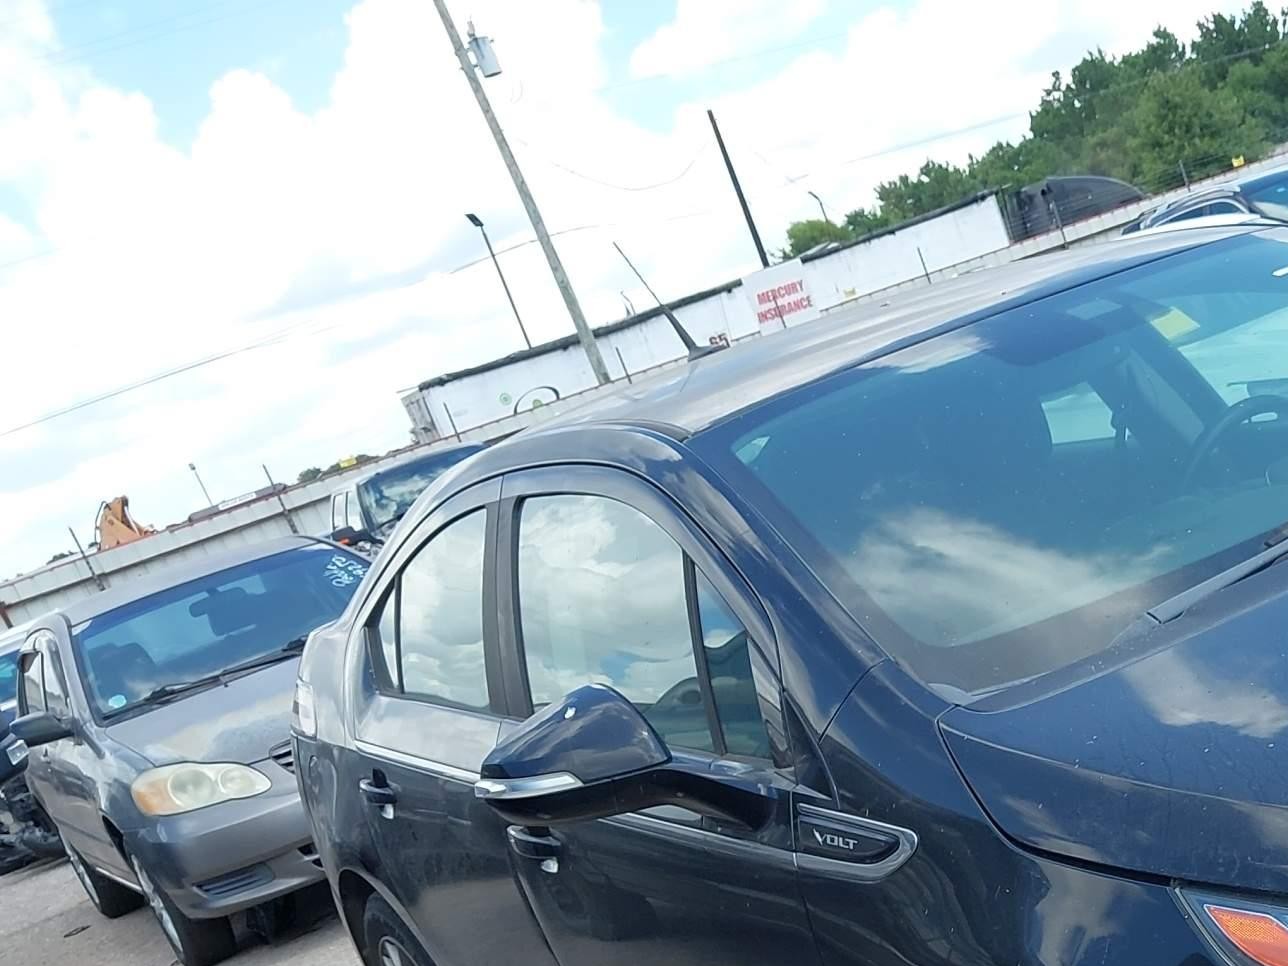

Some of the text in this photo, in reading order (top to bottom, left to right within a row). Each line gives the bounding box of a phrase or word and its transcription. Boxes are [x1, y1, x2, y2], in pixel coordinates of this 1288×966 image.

[757, 280, 804, 304] MERCURY
[757, 296, 813, 323] INSURANCE
[813, 828, 858, 850] VOLT
